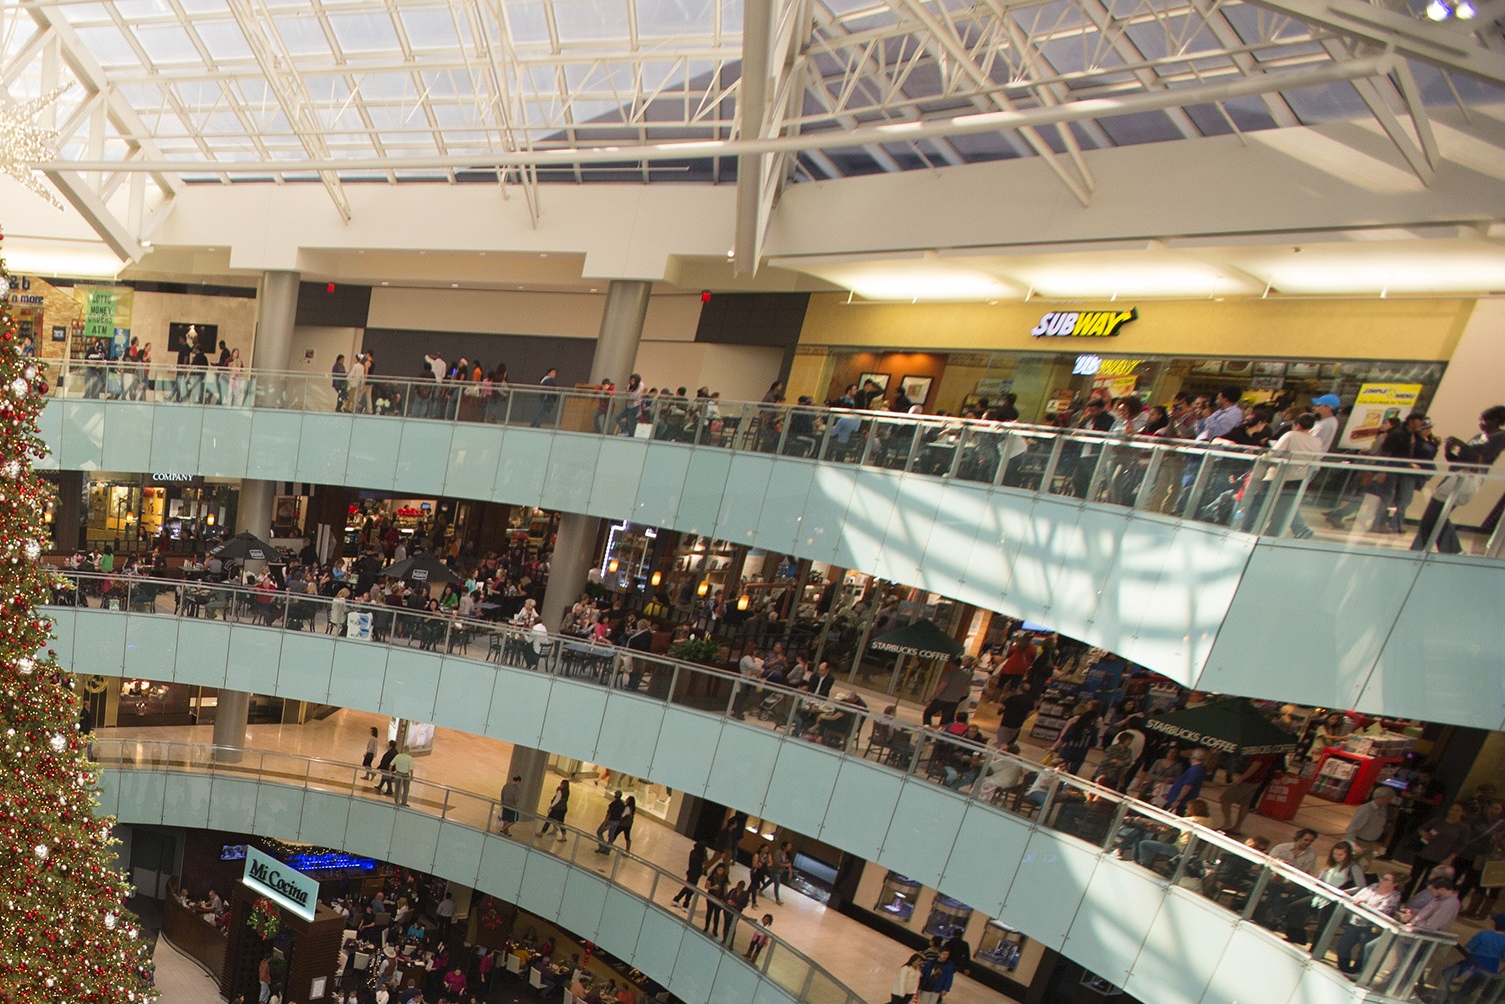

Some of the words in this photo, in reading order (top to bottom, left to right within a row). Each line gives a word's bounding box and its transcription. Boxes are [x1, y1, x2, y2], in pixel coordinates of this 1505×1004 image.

[1031, 308, 1137, 337] SUBWAY
[152, 472, 193, 481] COMPANY
[871, 641, 918, 656] STARBUCKS
[919, 650, 951, 661] COFFEE
[1145, 718, 1201, 742] STARBUCKS
[1200, 735, 1238, 754] COFFEE
[249, 858, 268, 880] Mi
[268, 870, 309, 904] Cocina
